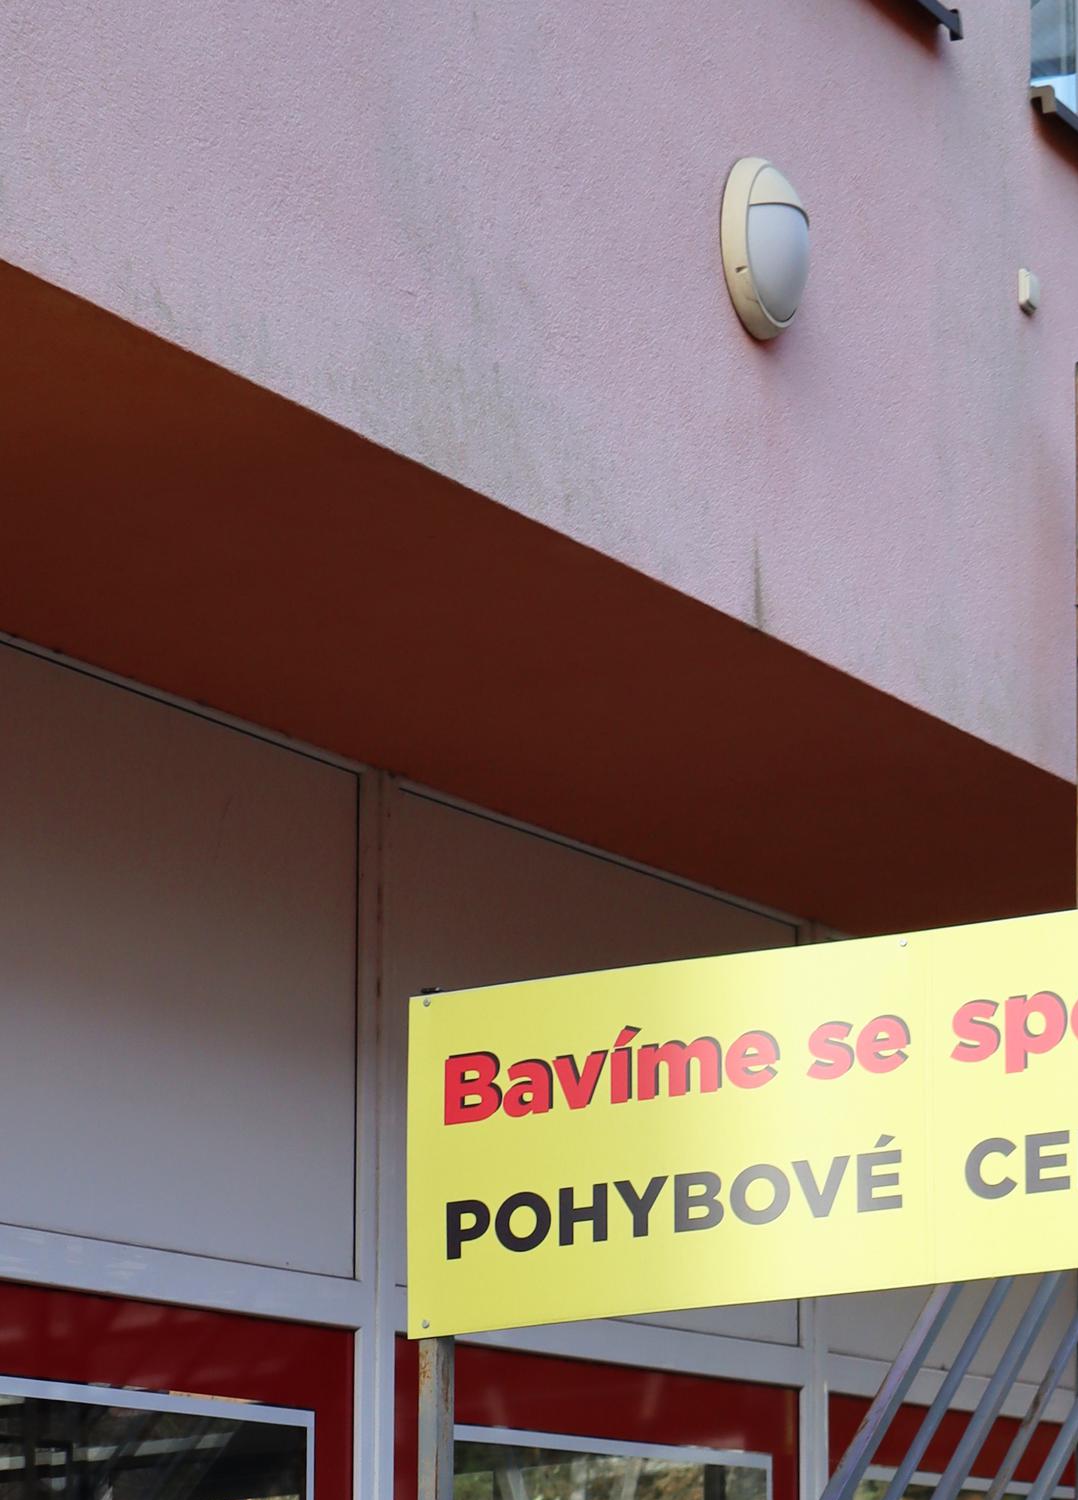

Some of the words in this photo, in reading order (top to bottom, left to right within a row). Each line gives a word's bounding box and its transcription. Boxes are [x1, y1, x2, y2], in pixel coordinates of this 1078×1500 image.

[444, 1025, 780, 1126] Bavíme
[807, 1013, 910, 1081] se
[445, 1134, 902, 1261] POHYBOVÉ
